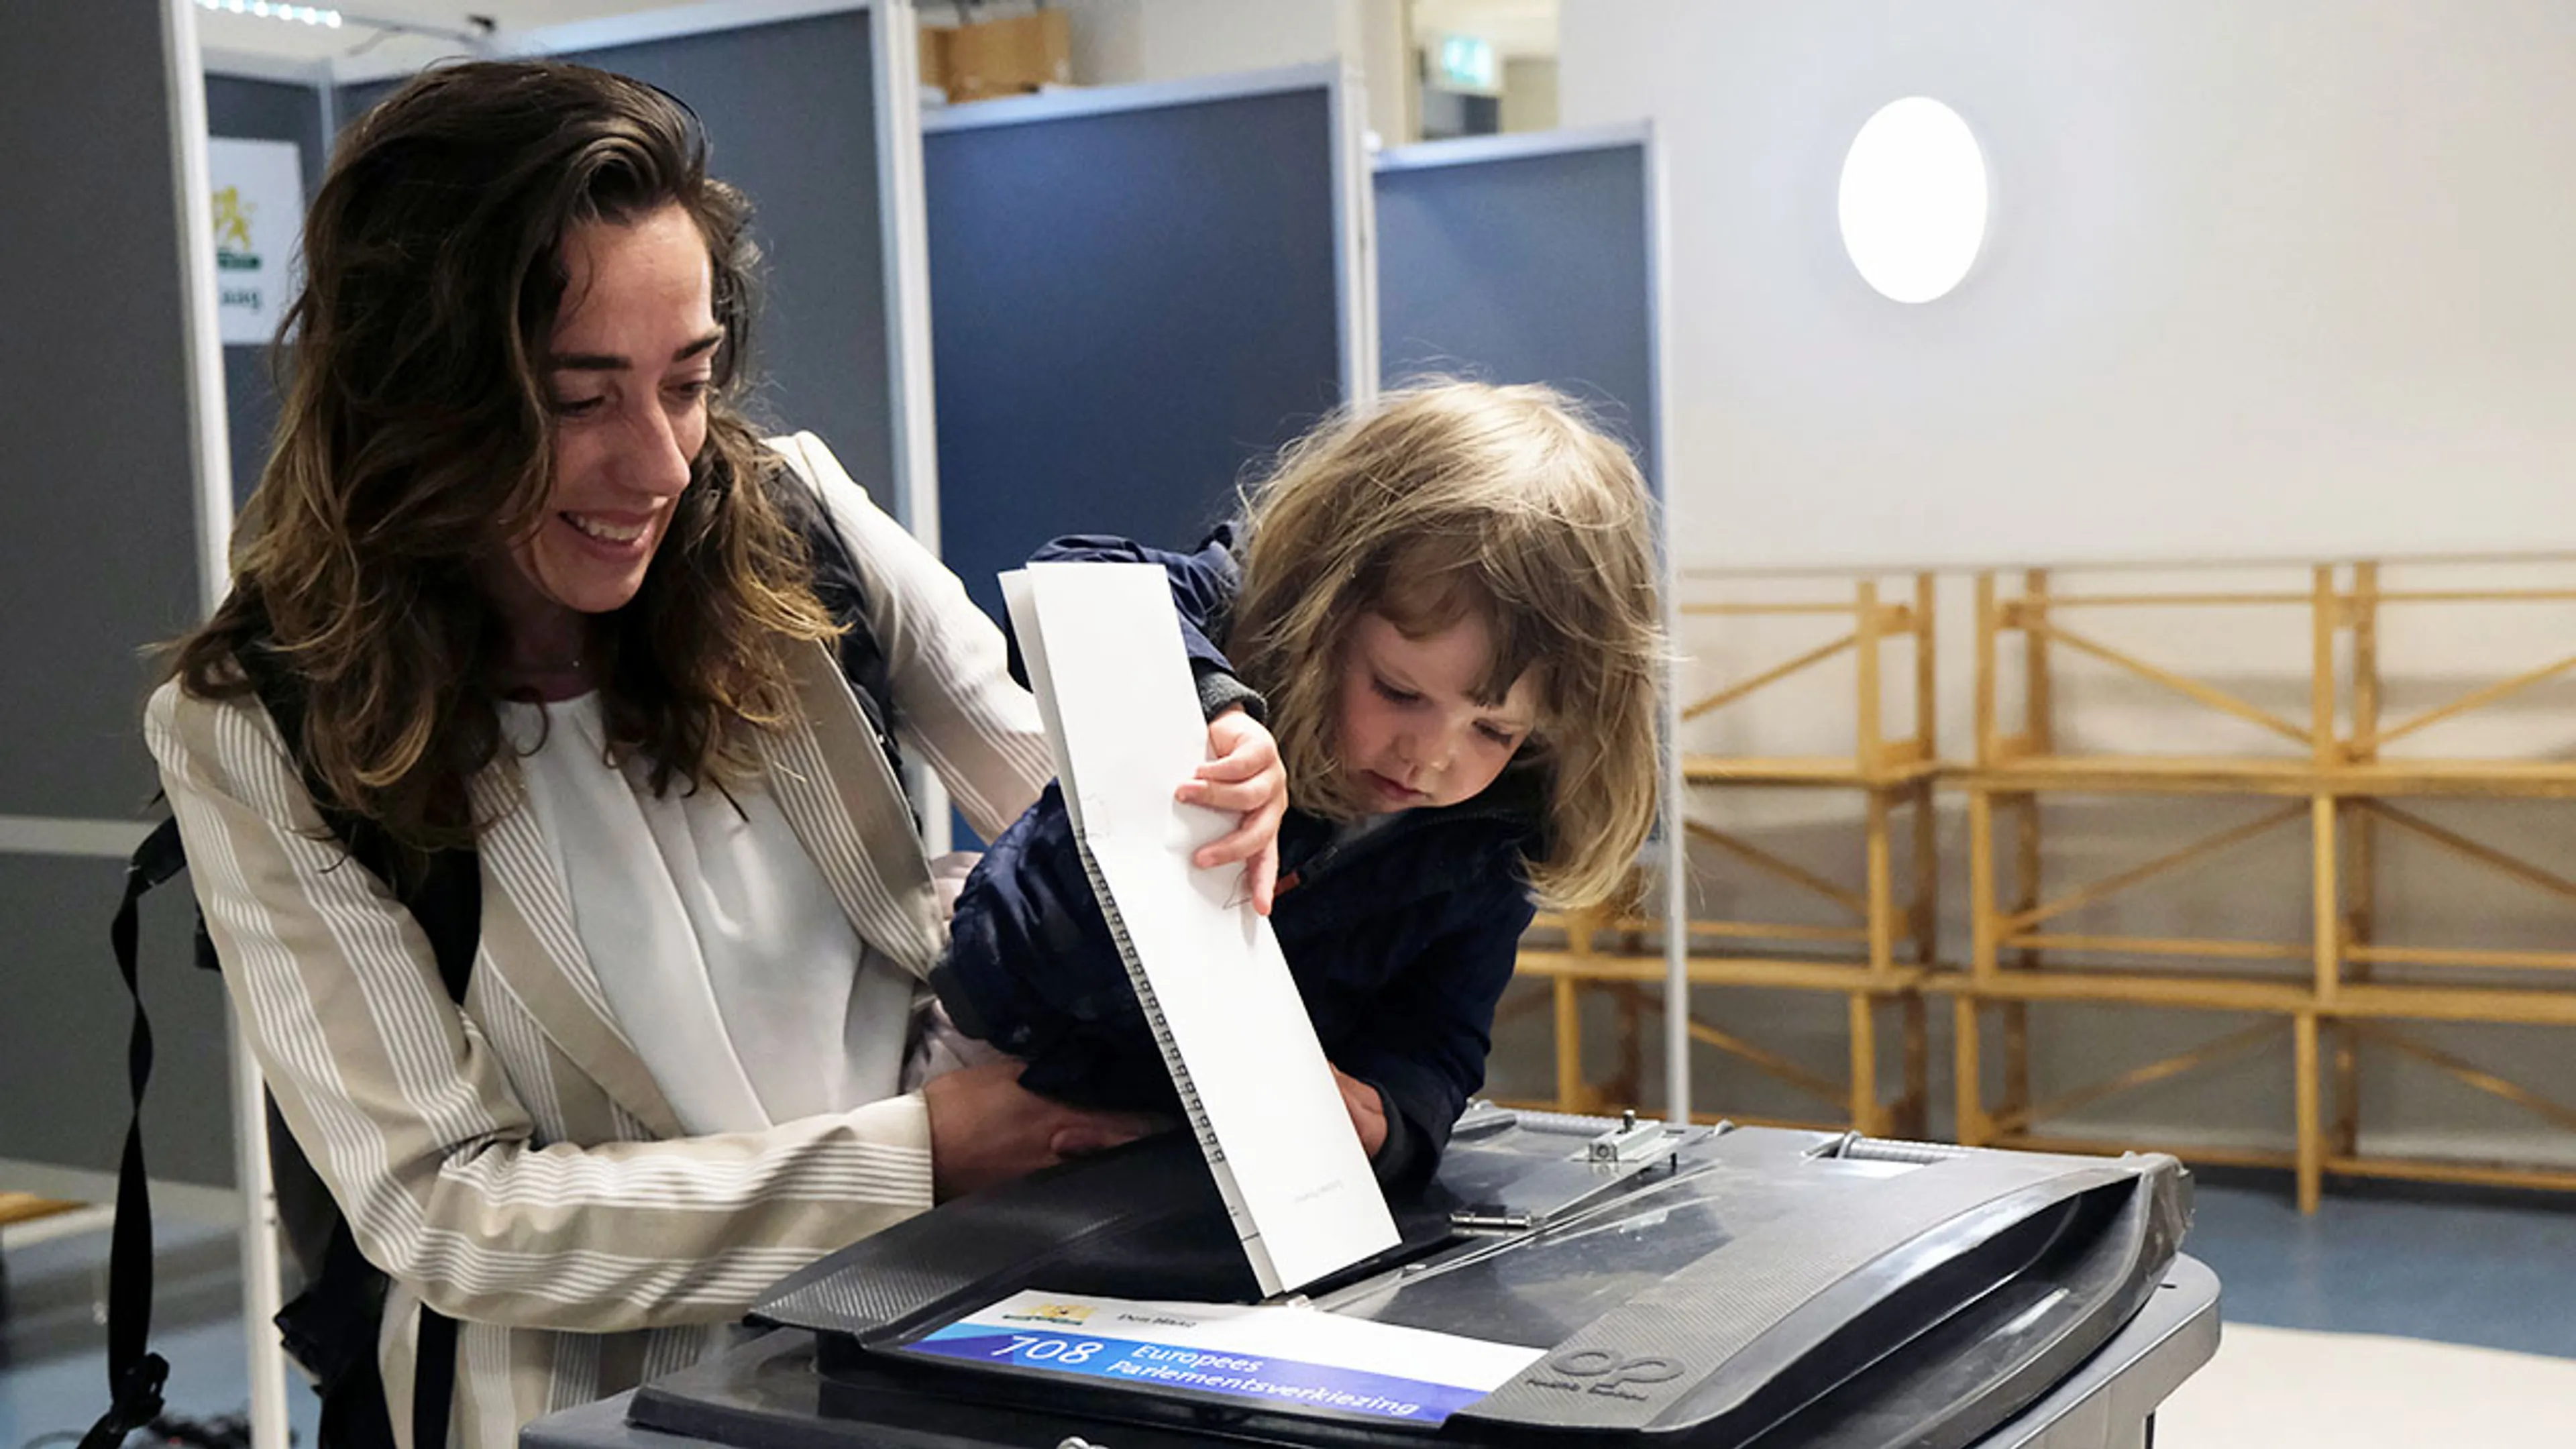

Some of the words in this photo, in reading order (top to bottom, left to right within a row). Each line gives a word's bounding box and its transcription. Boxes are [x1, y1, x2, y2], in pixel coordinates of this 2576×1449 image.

[990, 1335, 1104, 1364] 708
[1130, 1344, 1264, 1375] Europees
[1106, 1360, 1420, 1416] Parlementsverkiezing
